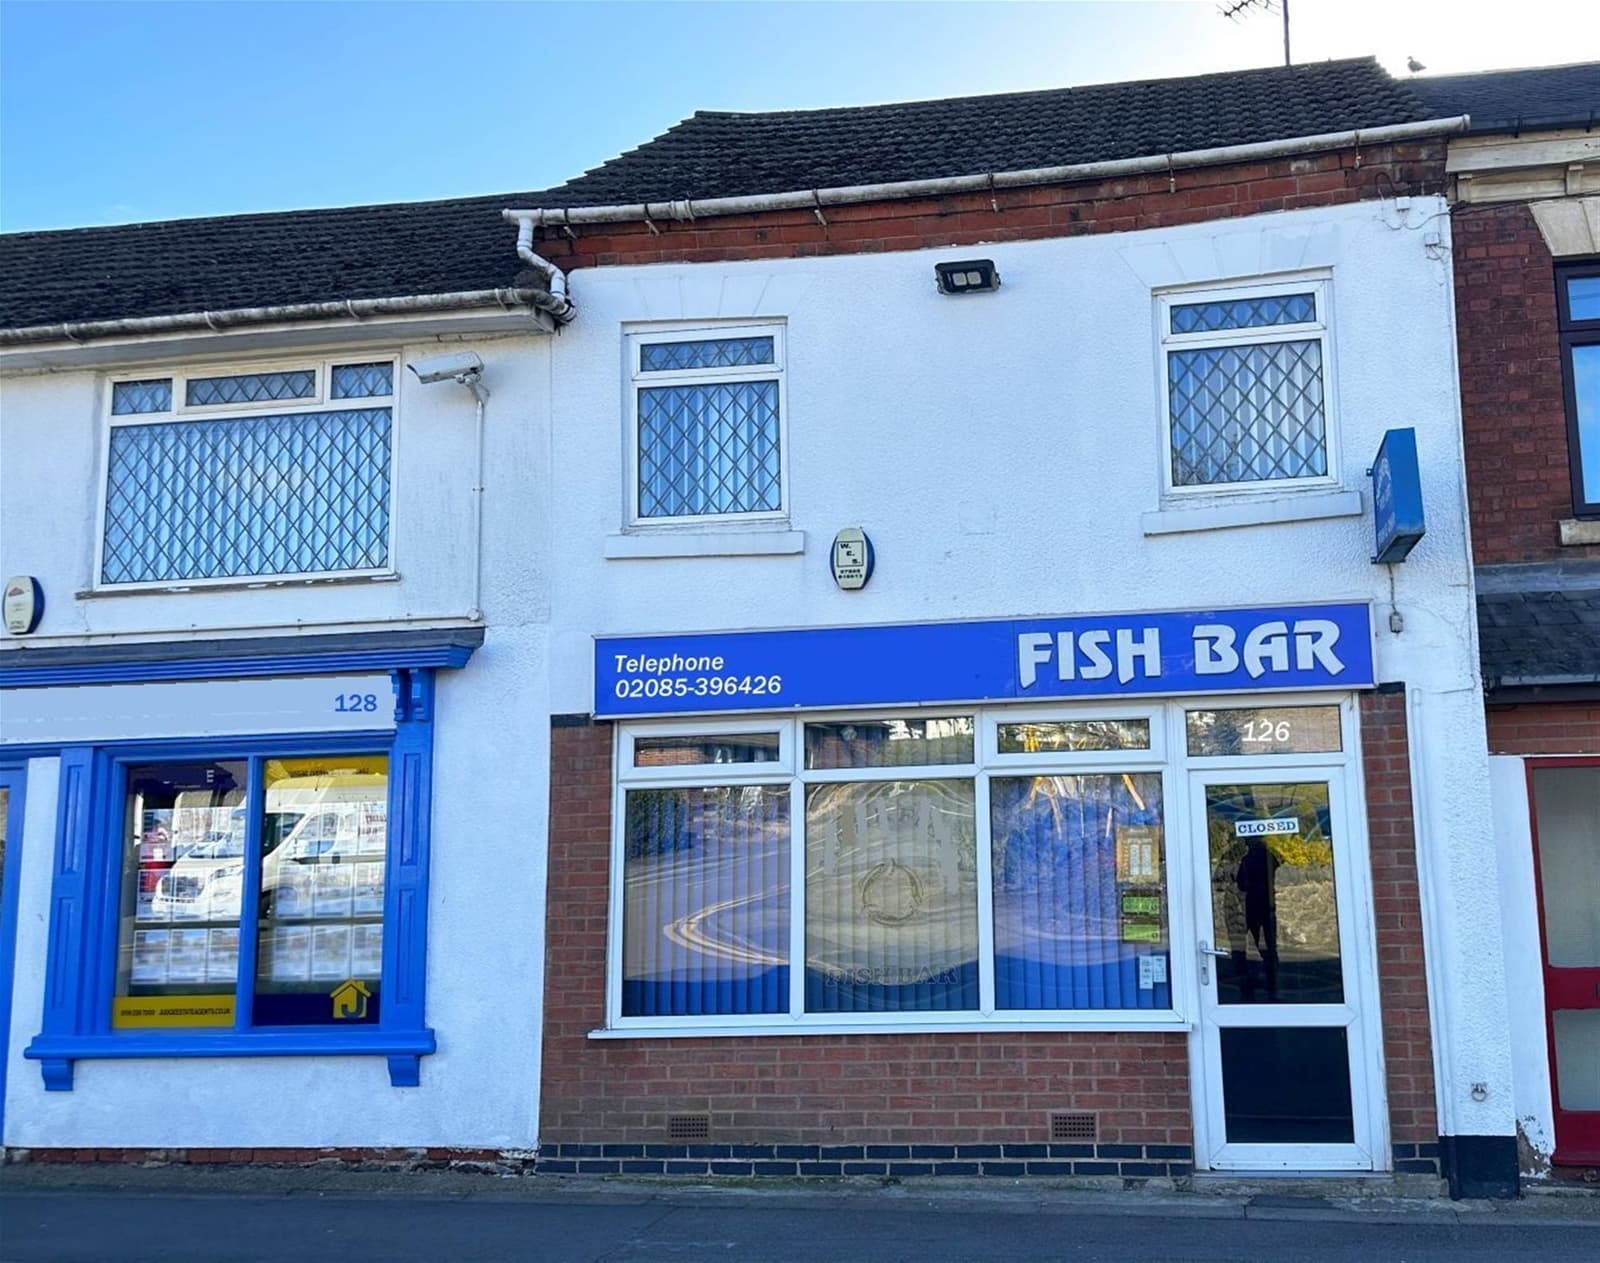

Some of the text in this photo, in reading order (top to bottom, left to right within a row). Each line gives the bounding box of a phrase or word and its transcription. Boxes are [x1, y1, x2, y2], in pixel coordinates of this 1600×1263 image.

[614, 653, 724, 676] Telephone
[1018, 619, 1346, 689] FISH BAR
[614, 675, 782, 698] 02085-396426
[335, 694, 377, 712] 128
[1242, 717, 1291, 743] 126
[1238, 821, 1296, 834] CLOSED
